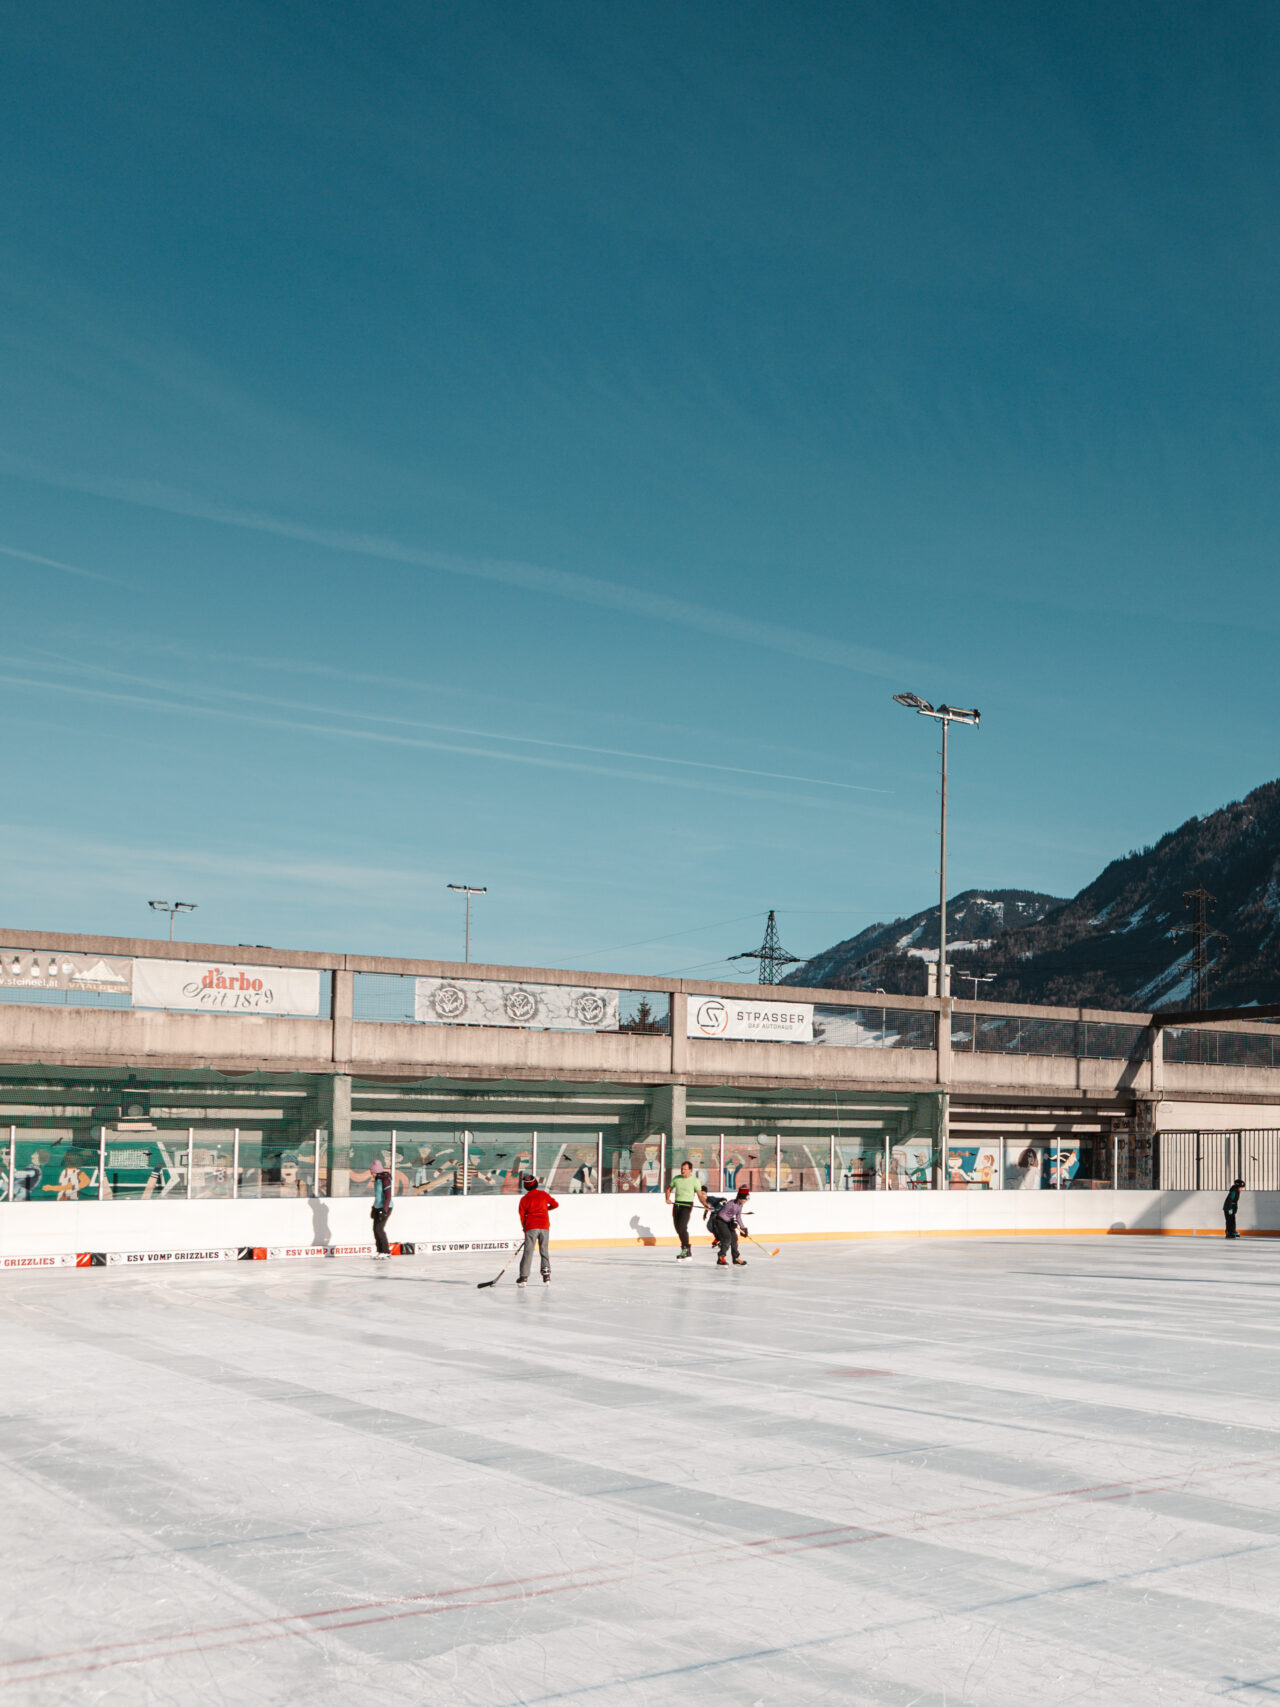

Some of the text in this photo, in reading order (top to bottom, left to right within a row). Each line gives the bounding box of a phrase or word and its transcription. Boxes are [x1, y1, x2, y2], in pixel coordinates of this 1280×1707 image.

[233, 988, 274, 1008] 1879
[736, 1011, 805, 1023] STRASSER
[286, 1246, 372, 1257] ESV VOMP GRIZZLIES
[431, 1242, 509, 1252] ESV VOMP GRIZZLIES
[4, 1257, 55, 1267] GRIZZLIES
[127, 1251, 220, 1262] ESV VOMP GRIZZLIES
